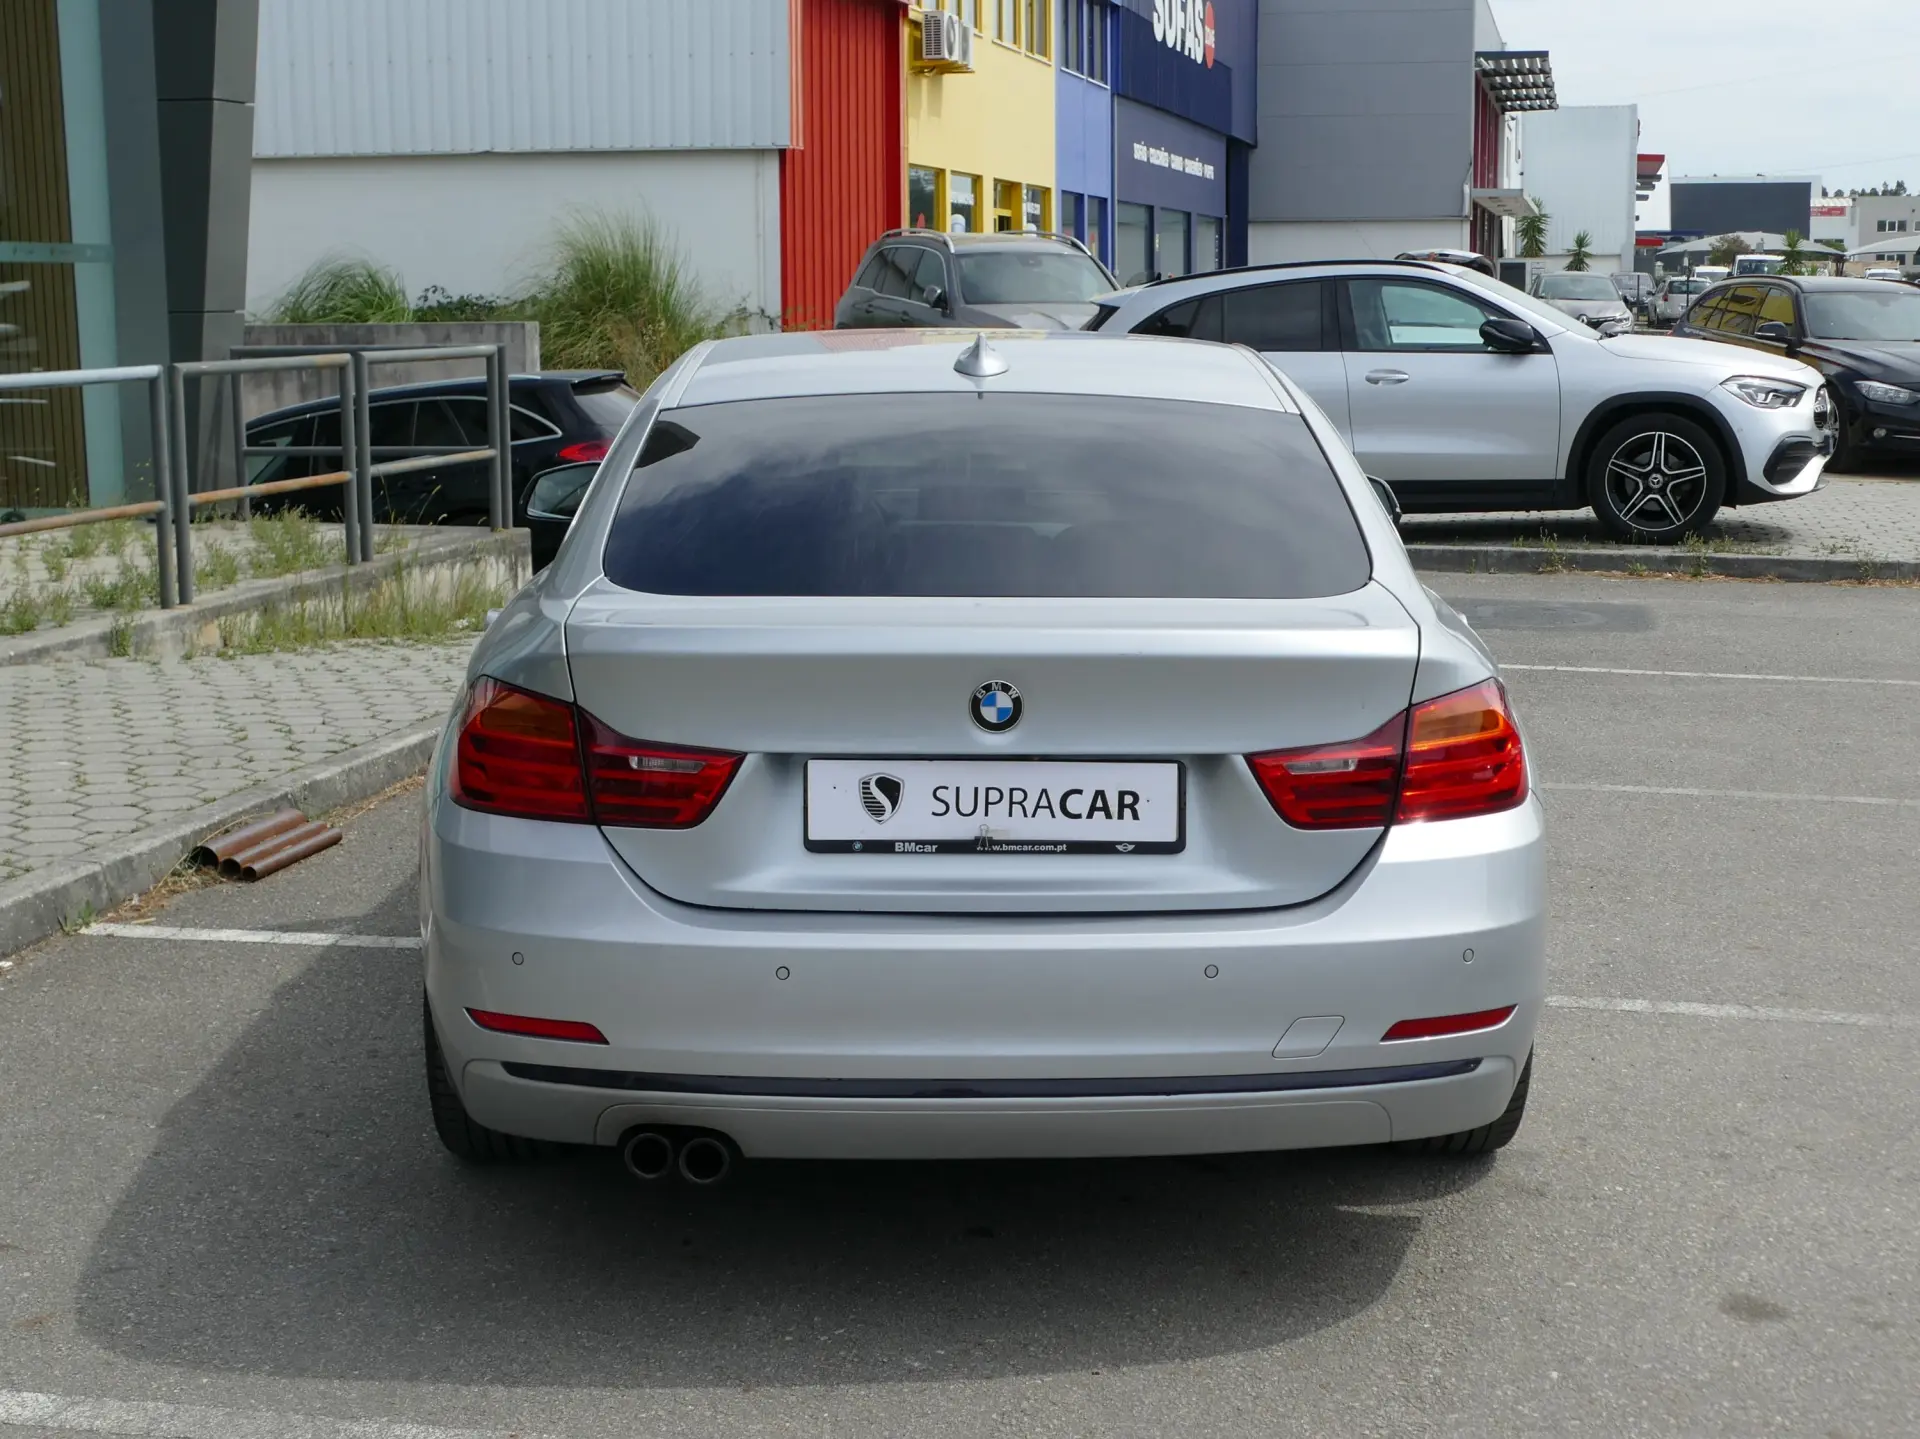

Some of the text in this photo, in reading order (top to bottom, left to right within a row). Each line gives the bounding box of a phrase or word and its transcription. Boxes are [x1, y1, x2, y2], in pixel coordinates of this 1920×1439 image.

[975, 681, 1019, 700] BMW
[931, 785, 1140, 821] SUPRACAR
[895, 842, 938, 853] BMcar
